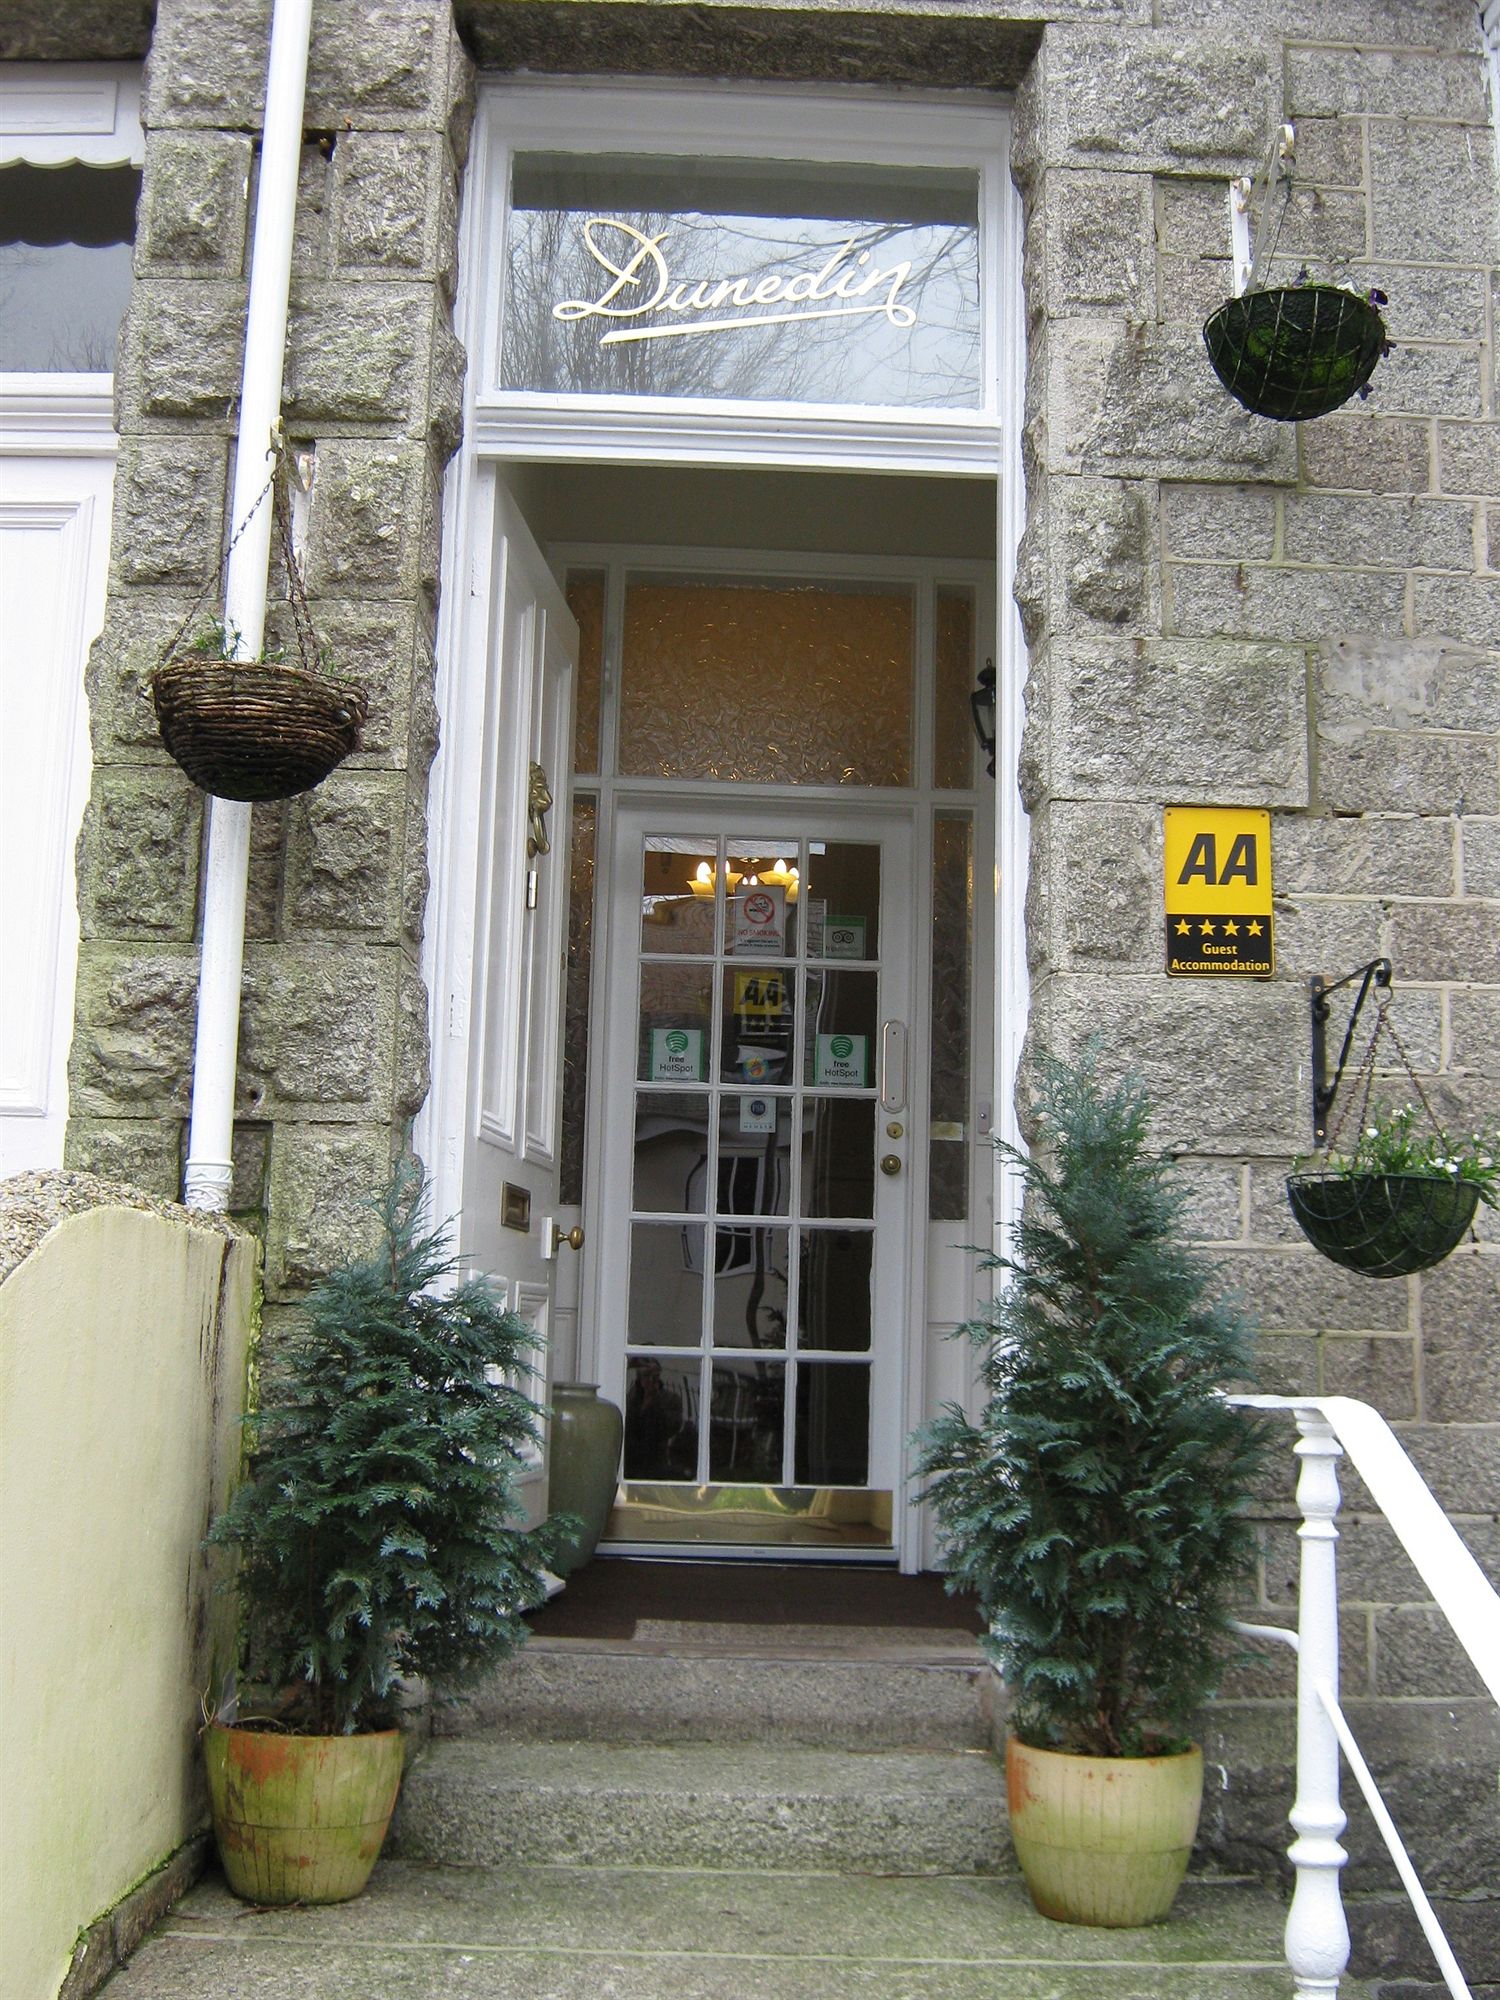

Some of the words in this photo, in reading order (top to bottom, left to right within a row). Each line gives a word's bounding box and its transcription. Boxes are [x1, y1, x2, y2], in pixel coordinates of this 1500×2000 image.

[552, 217, 917, 343] Dunedin
[1177, 833, 1258, 886] AA
[737, 929, 749, 937] NO
[1202, 942, 1238, 955] Guest
[1171, 958, 1270, 971] Accommodation
[739, 979, 779, 1007] AA
[659, 1063, 693, 1073] HotSpot
[833, 1060, 850, 1068] free
[824, 1068, 858, 1078] HotSpot
